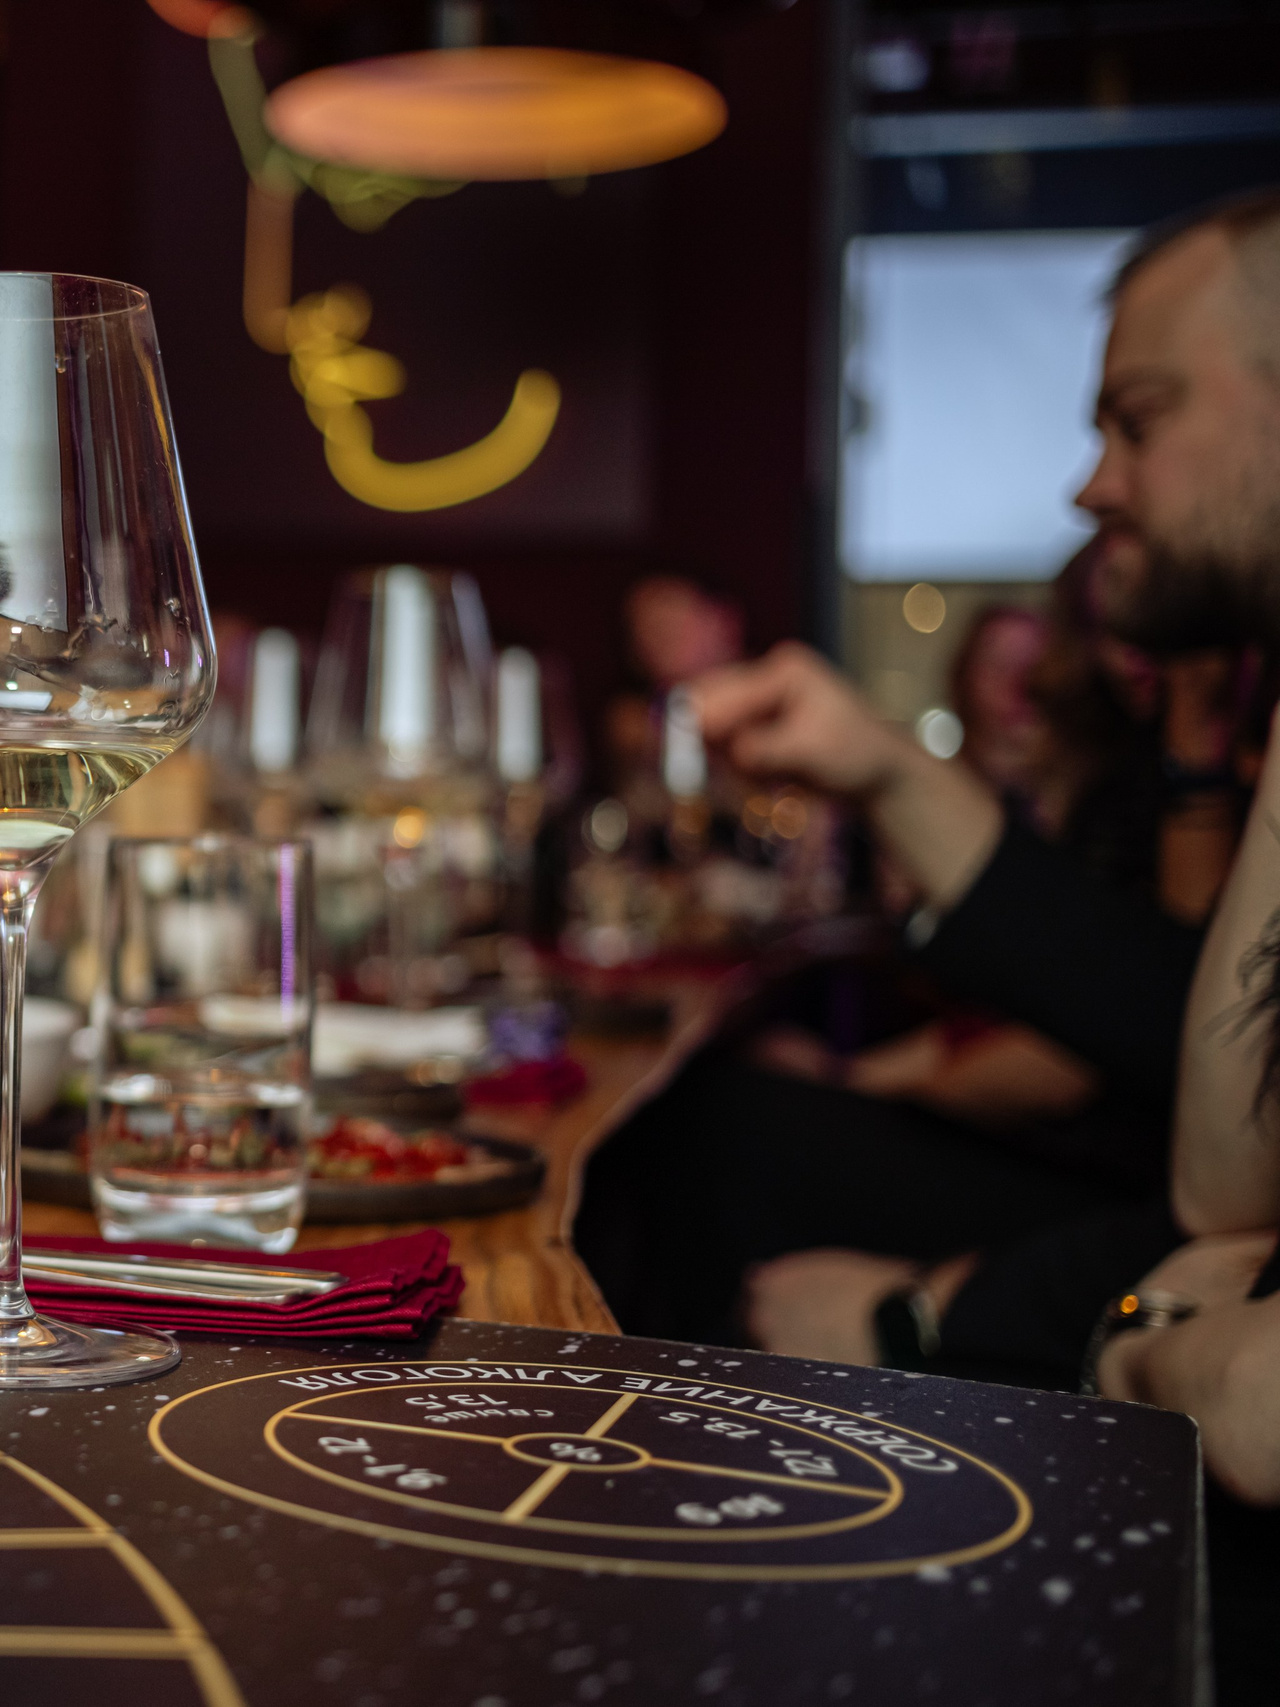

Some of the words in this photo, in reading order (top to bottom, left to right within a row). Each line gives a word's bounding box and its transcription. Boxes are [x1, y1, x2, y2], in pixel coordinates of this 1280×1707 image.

[277, 1366, 604, 1391] АЛКОГОЛЯ
[404, 1393, 508, 1410] 13,5
[423, 1408, 555, 1423] свыше
